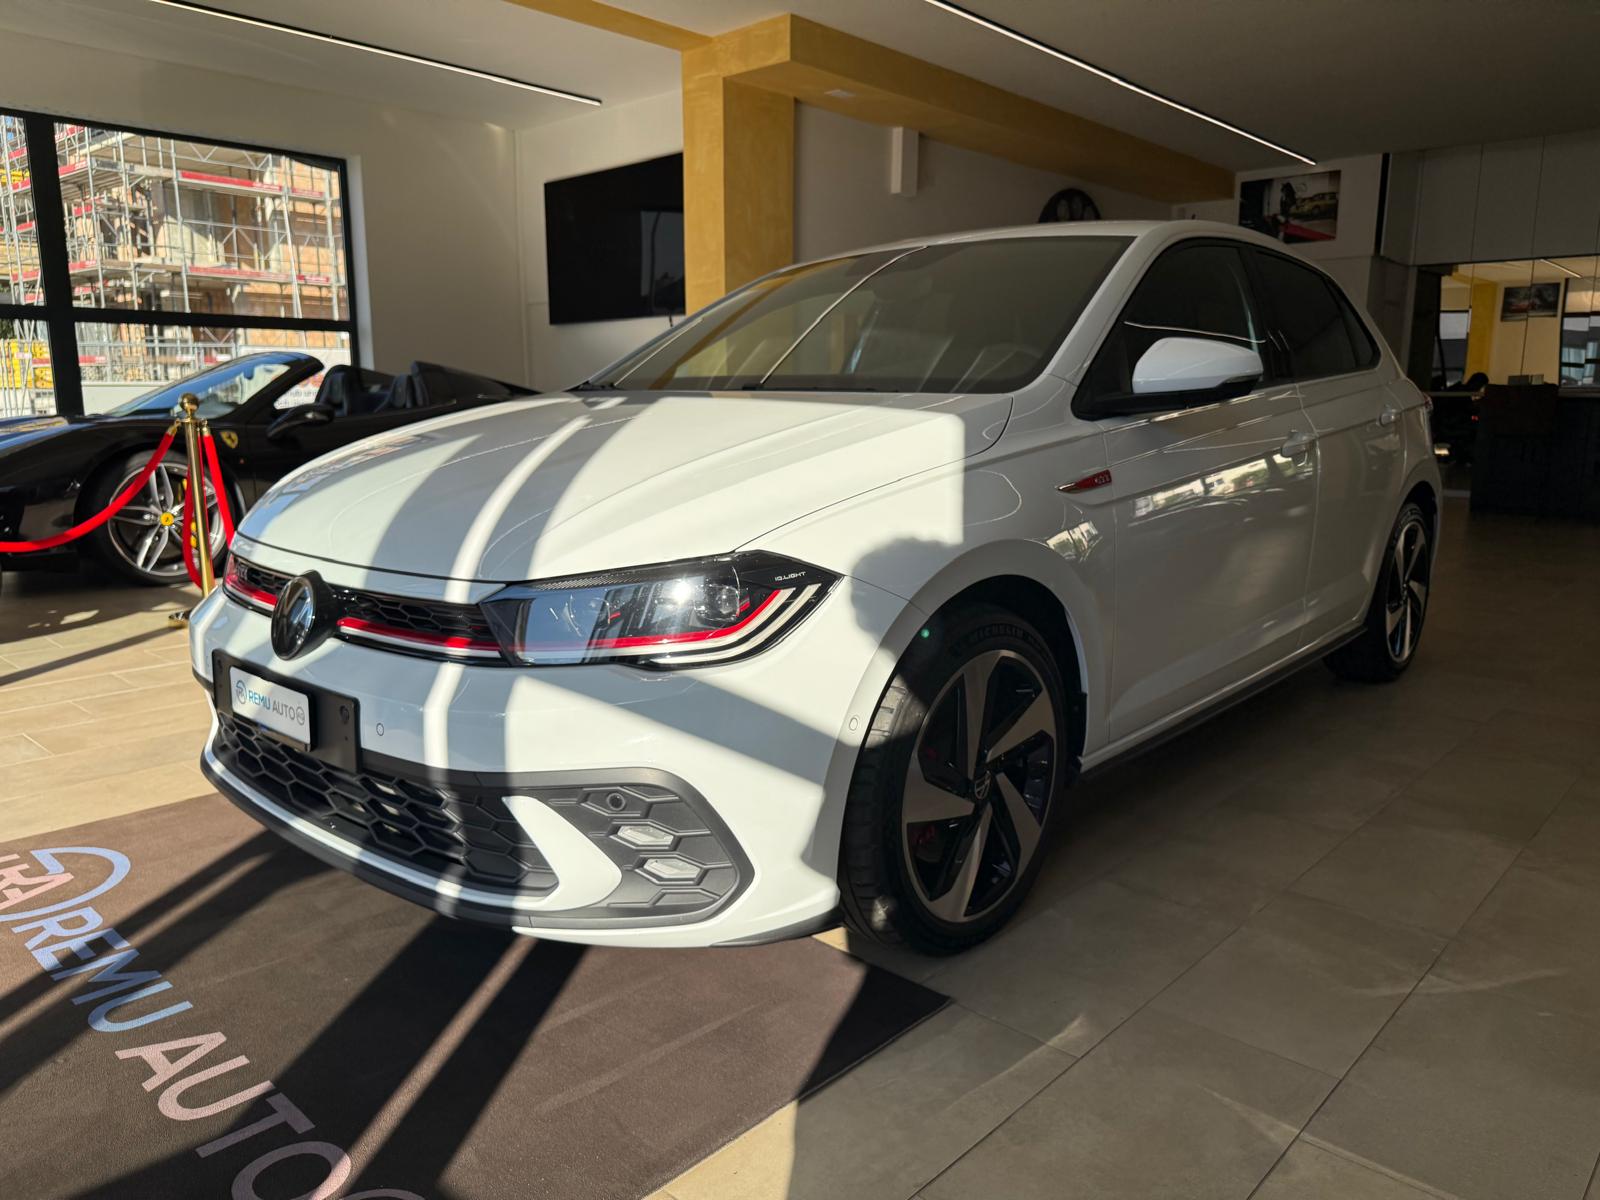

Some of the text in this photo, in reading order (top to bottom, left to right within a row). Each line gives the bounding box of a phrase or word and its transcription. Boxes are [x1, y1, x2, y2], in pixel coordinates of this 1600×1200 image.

[248, 690, 271, 710] REMU
[272, 700, 295, 720] AUTO
[11, 906, 352, 1200] REMU AUTO
